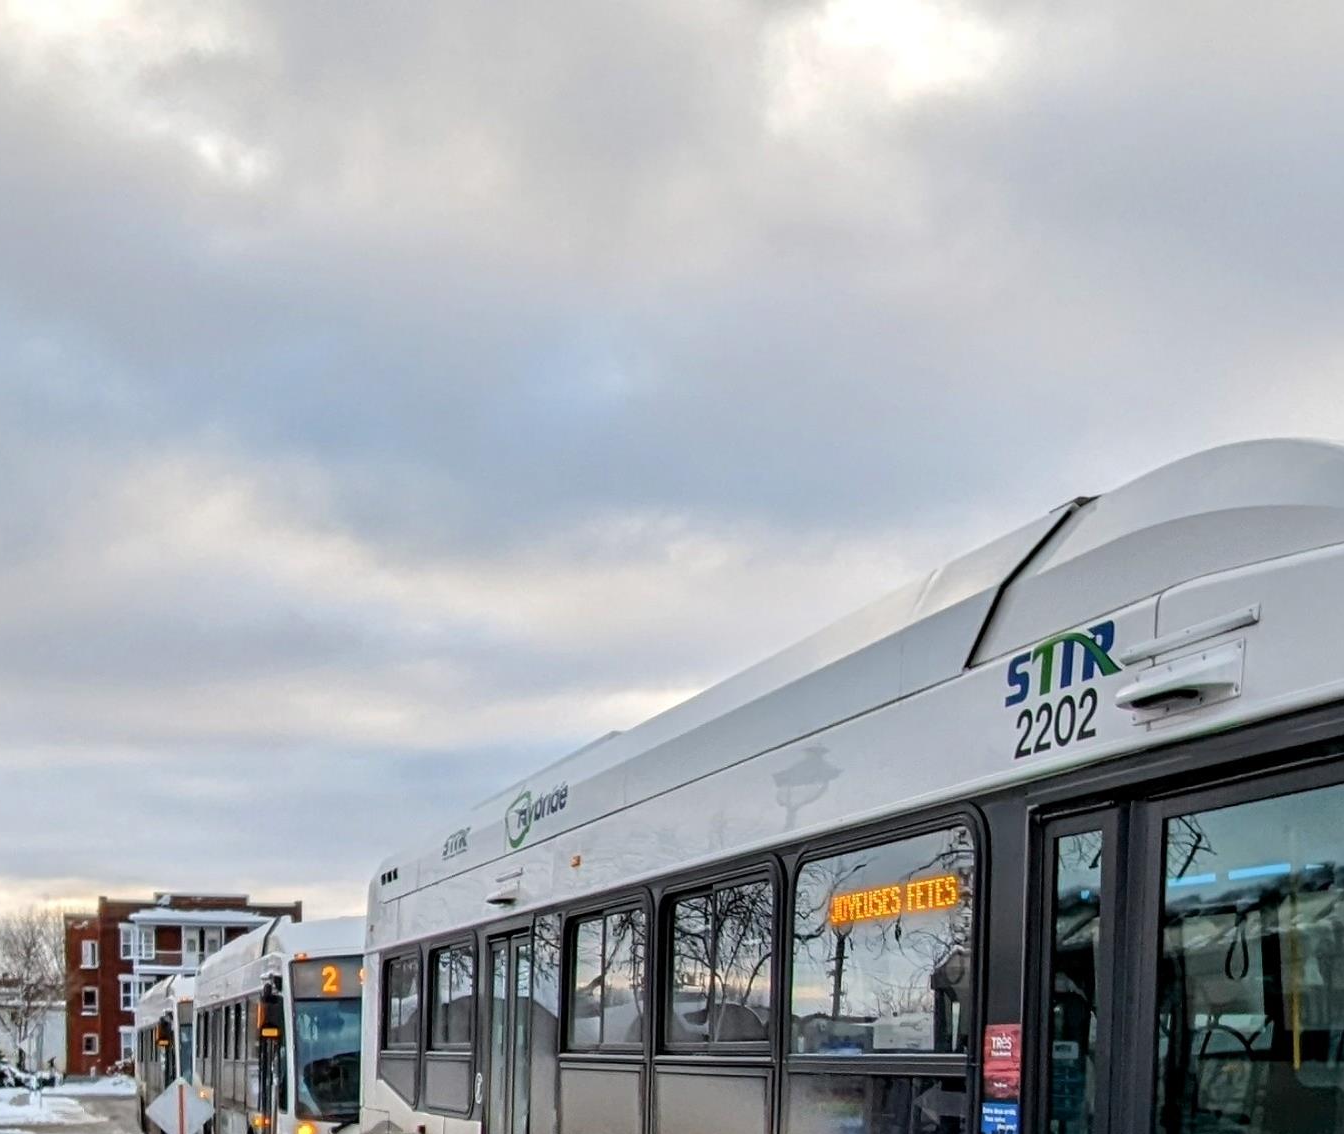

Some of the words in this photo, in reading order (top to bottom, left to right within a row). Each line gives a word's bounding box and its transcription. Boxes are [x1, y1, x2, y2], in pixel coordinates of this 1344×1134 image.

[1004, 619, 1124, 708] STTR
[1013, 687, 1098, 760] 2202
[830, 885, 901, 924] JOYEUSES
[906, 875, 958, 912] FETES
[321, 965, 338, 993] 2
